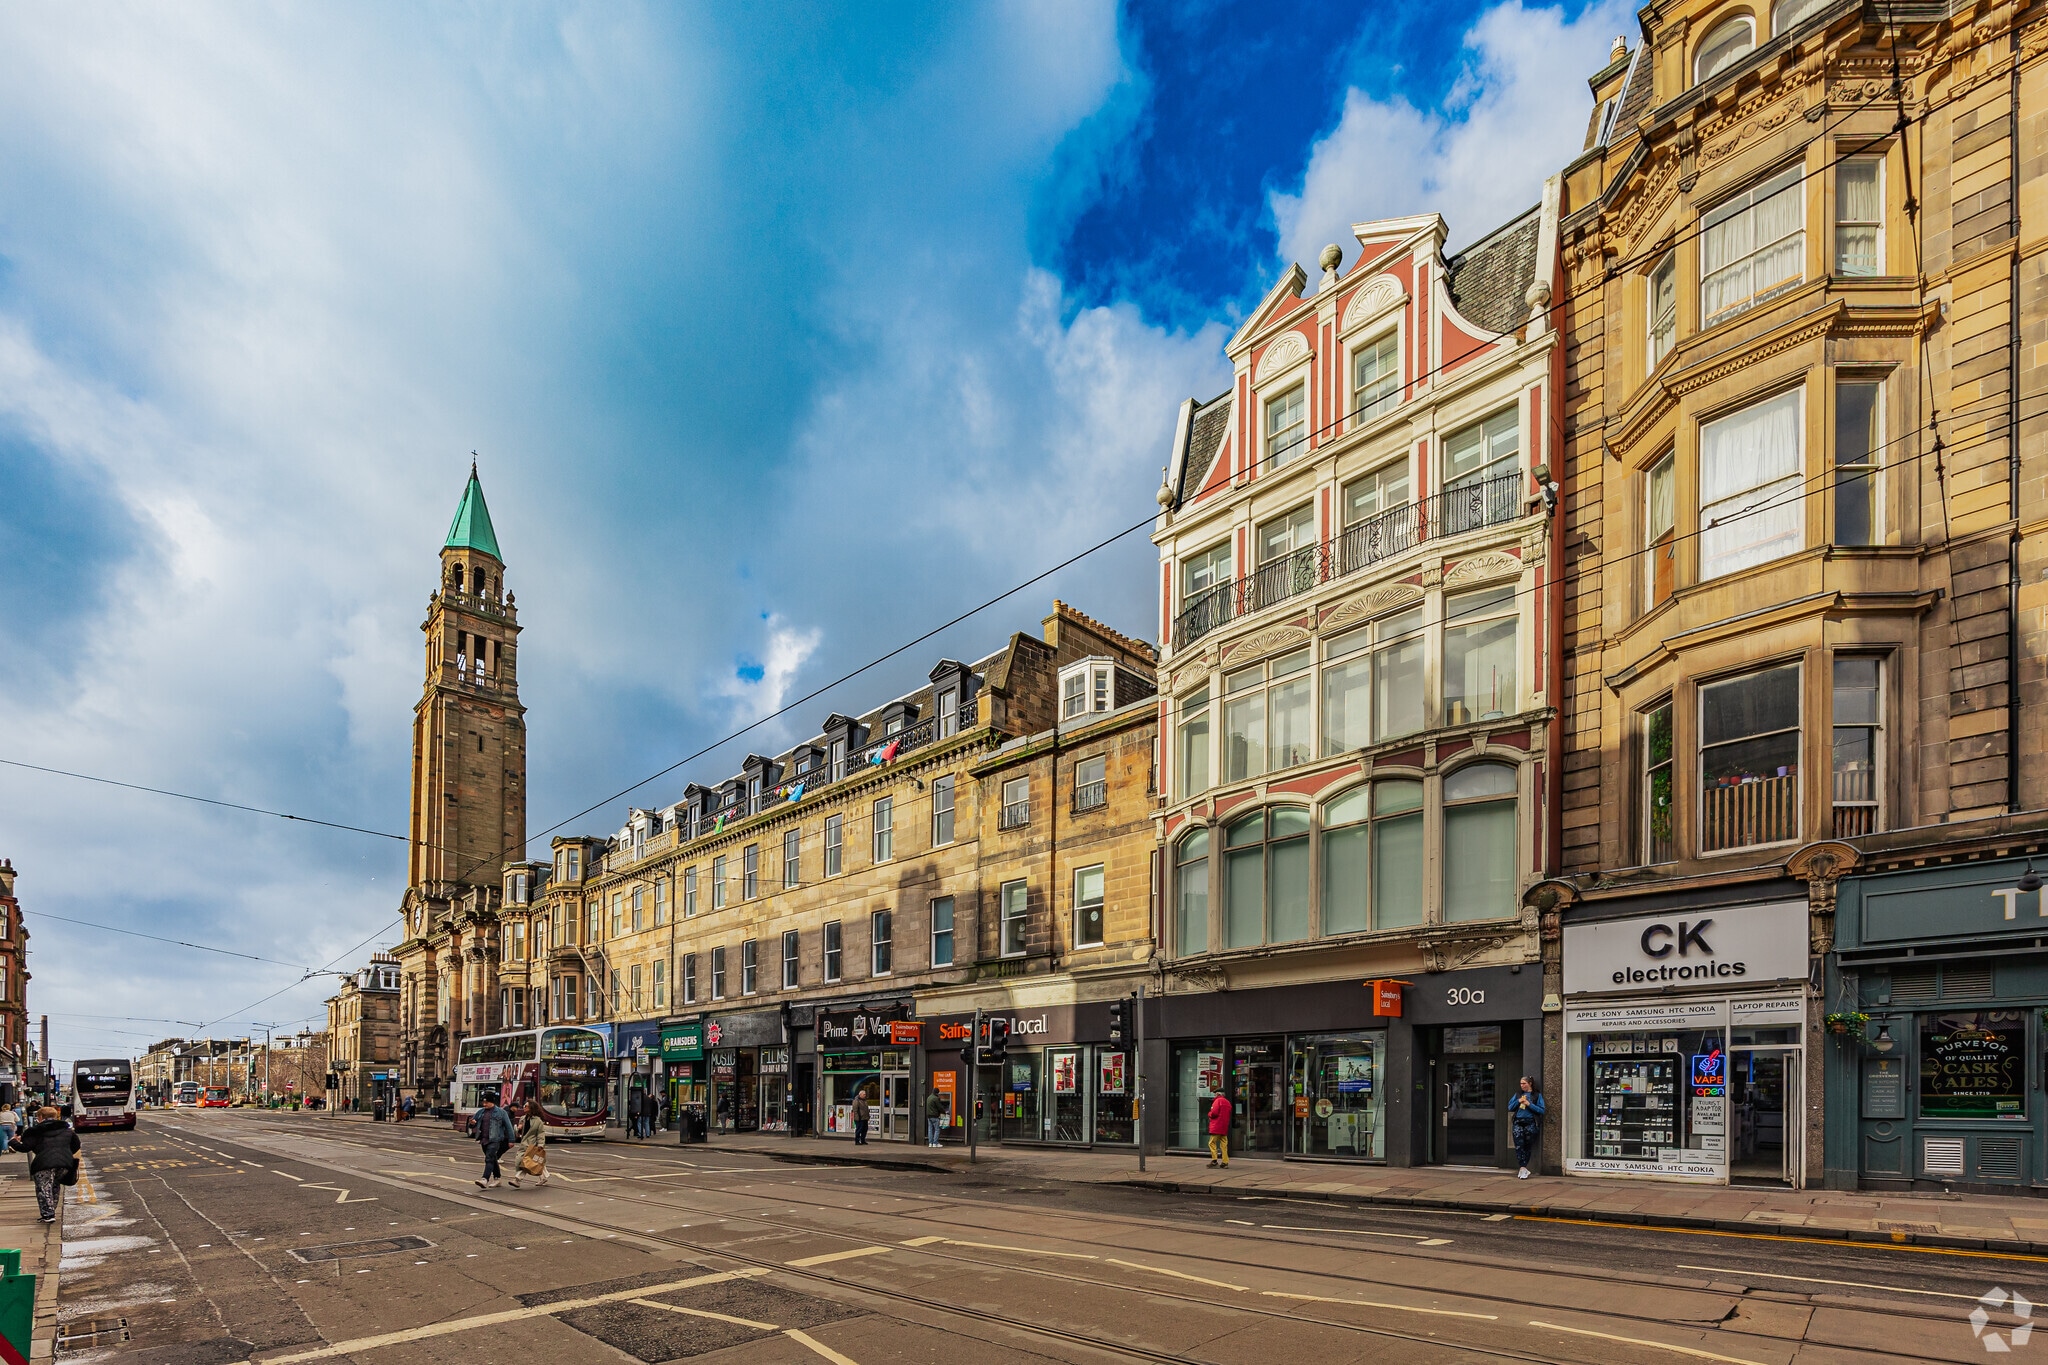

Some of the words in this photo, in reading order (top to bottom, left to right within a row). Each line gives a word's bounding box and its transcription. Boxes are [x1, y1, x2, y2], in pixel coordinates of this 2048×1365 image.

[1991, 885, 2048, 920] T
[1641, 918, 1714, 958] CK
[1612, 960, 1746, 983] electronics
[1381, 990, 1400, 1000] Sainsbury's
[1446, 987, 1485, 1005] 30a
[1381, 999, 1390, 1008] Local
[1626, 1008, 1664, 1016] SAMSUNG
[824, 1021, 848, 1038] Prime
[1011, 1014, 1048, 1034] Local
[670, 1036, 697, 1046] RAMSDENS
[1936, 1040, 2008, 1055] PURVEYOR
[712, 1051, 736, 1066] MUSIC
[760, 1047, 788, 1064] FILMS
[590, 1068, 596, 1076] 4
[1944, 1062, 2000, 1074] CASK
[1694, 1076, 1724, 1084] VAPE
[1945, 1076, 1998, 1088] ALES
[1696, 1088, 1724, 1098] open
